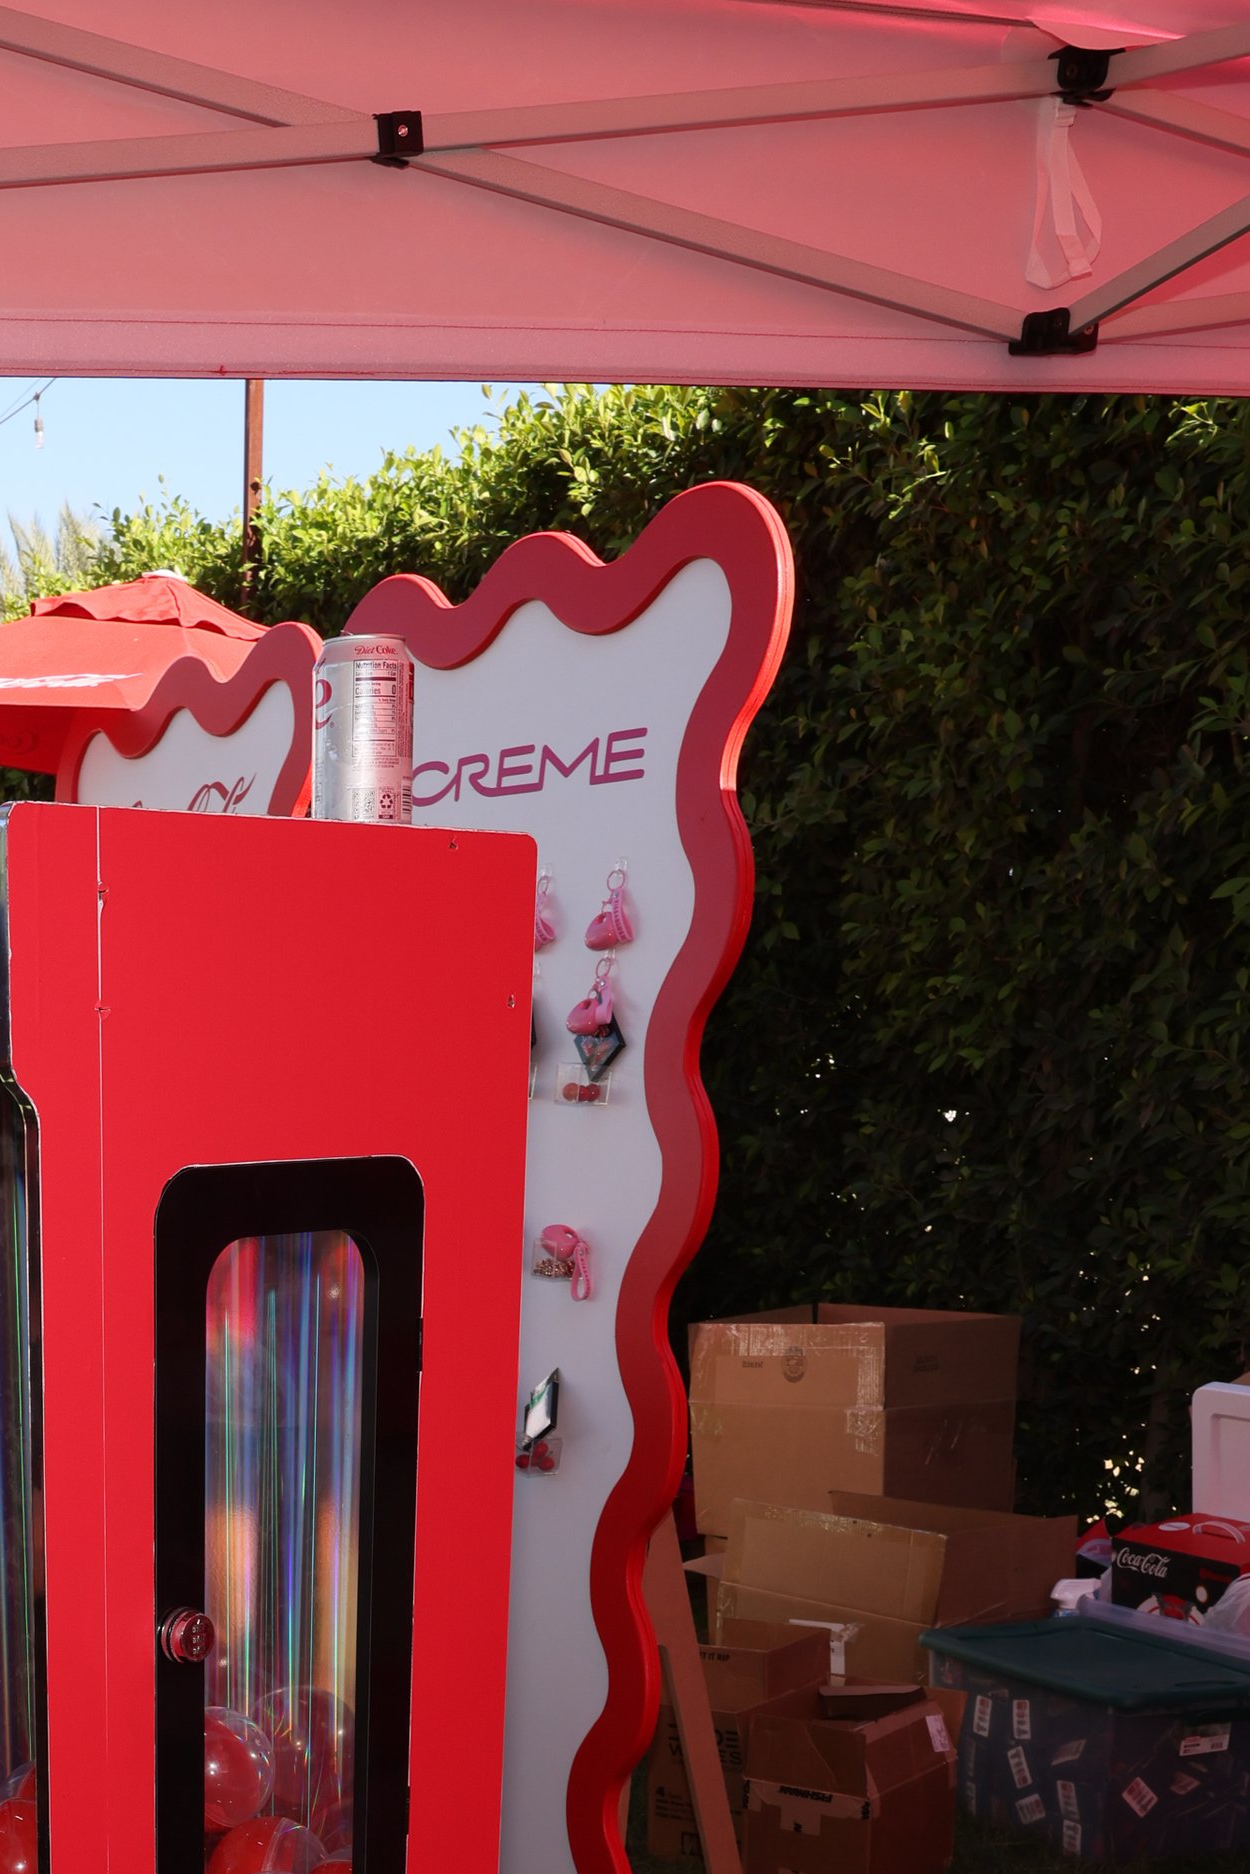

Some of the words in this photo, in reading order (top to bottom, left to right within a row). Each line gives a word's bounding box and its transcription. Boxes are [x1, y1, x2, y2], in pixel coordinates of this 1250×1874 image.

[355, 645, 375, 655] Diet
[376, 645, 398, 655] Coke
[412, 727, 648, 807] CREME
[1116, 1547, 1171, 1578] Coca-Cola
